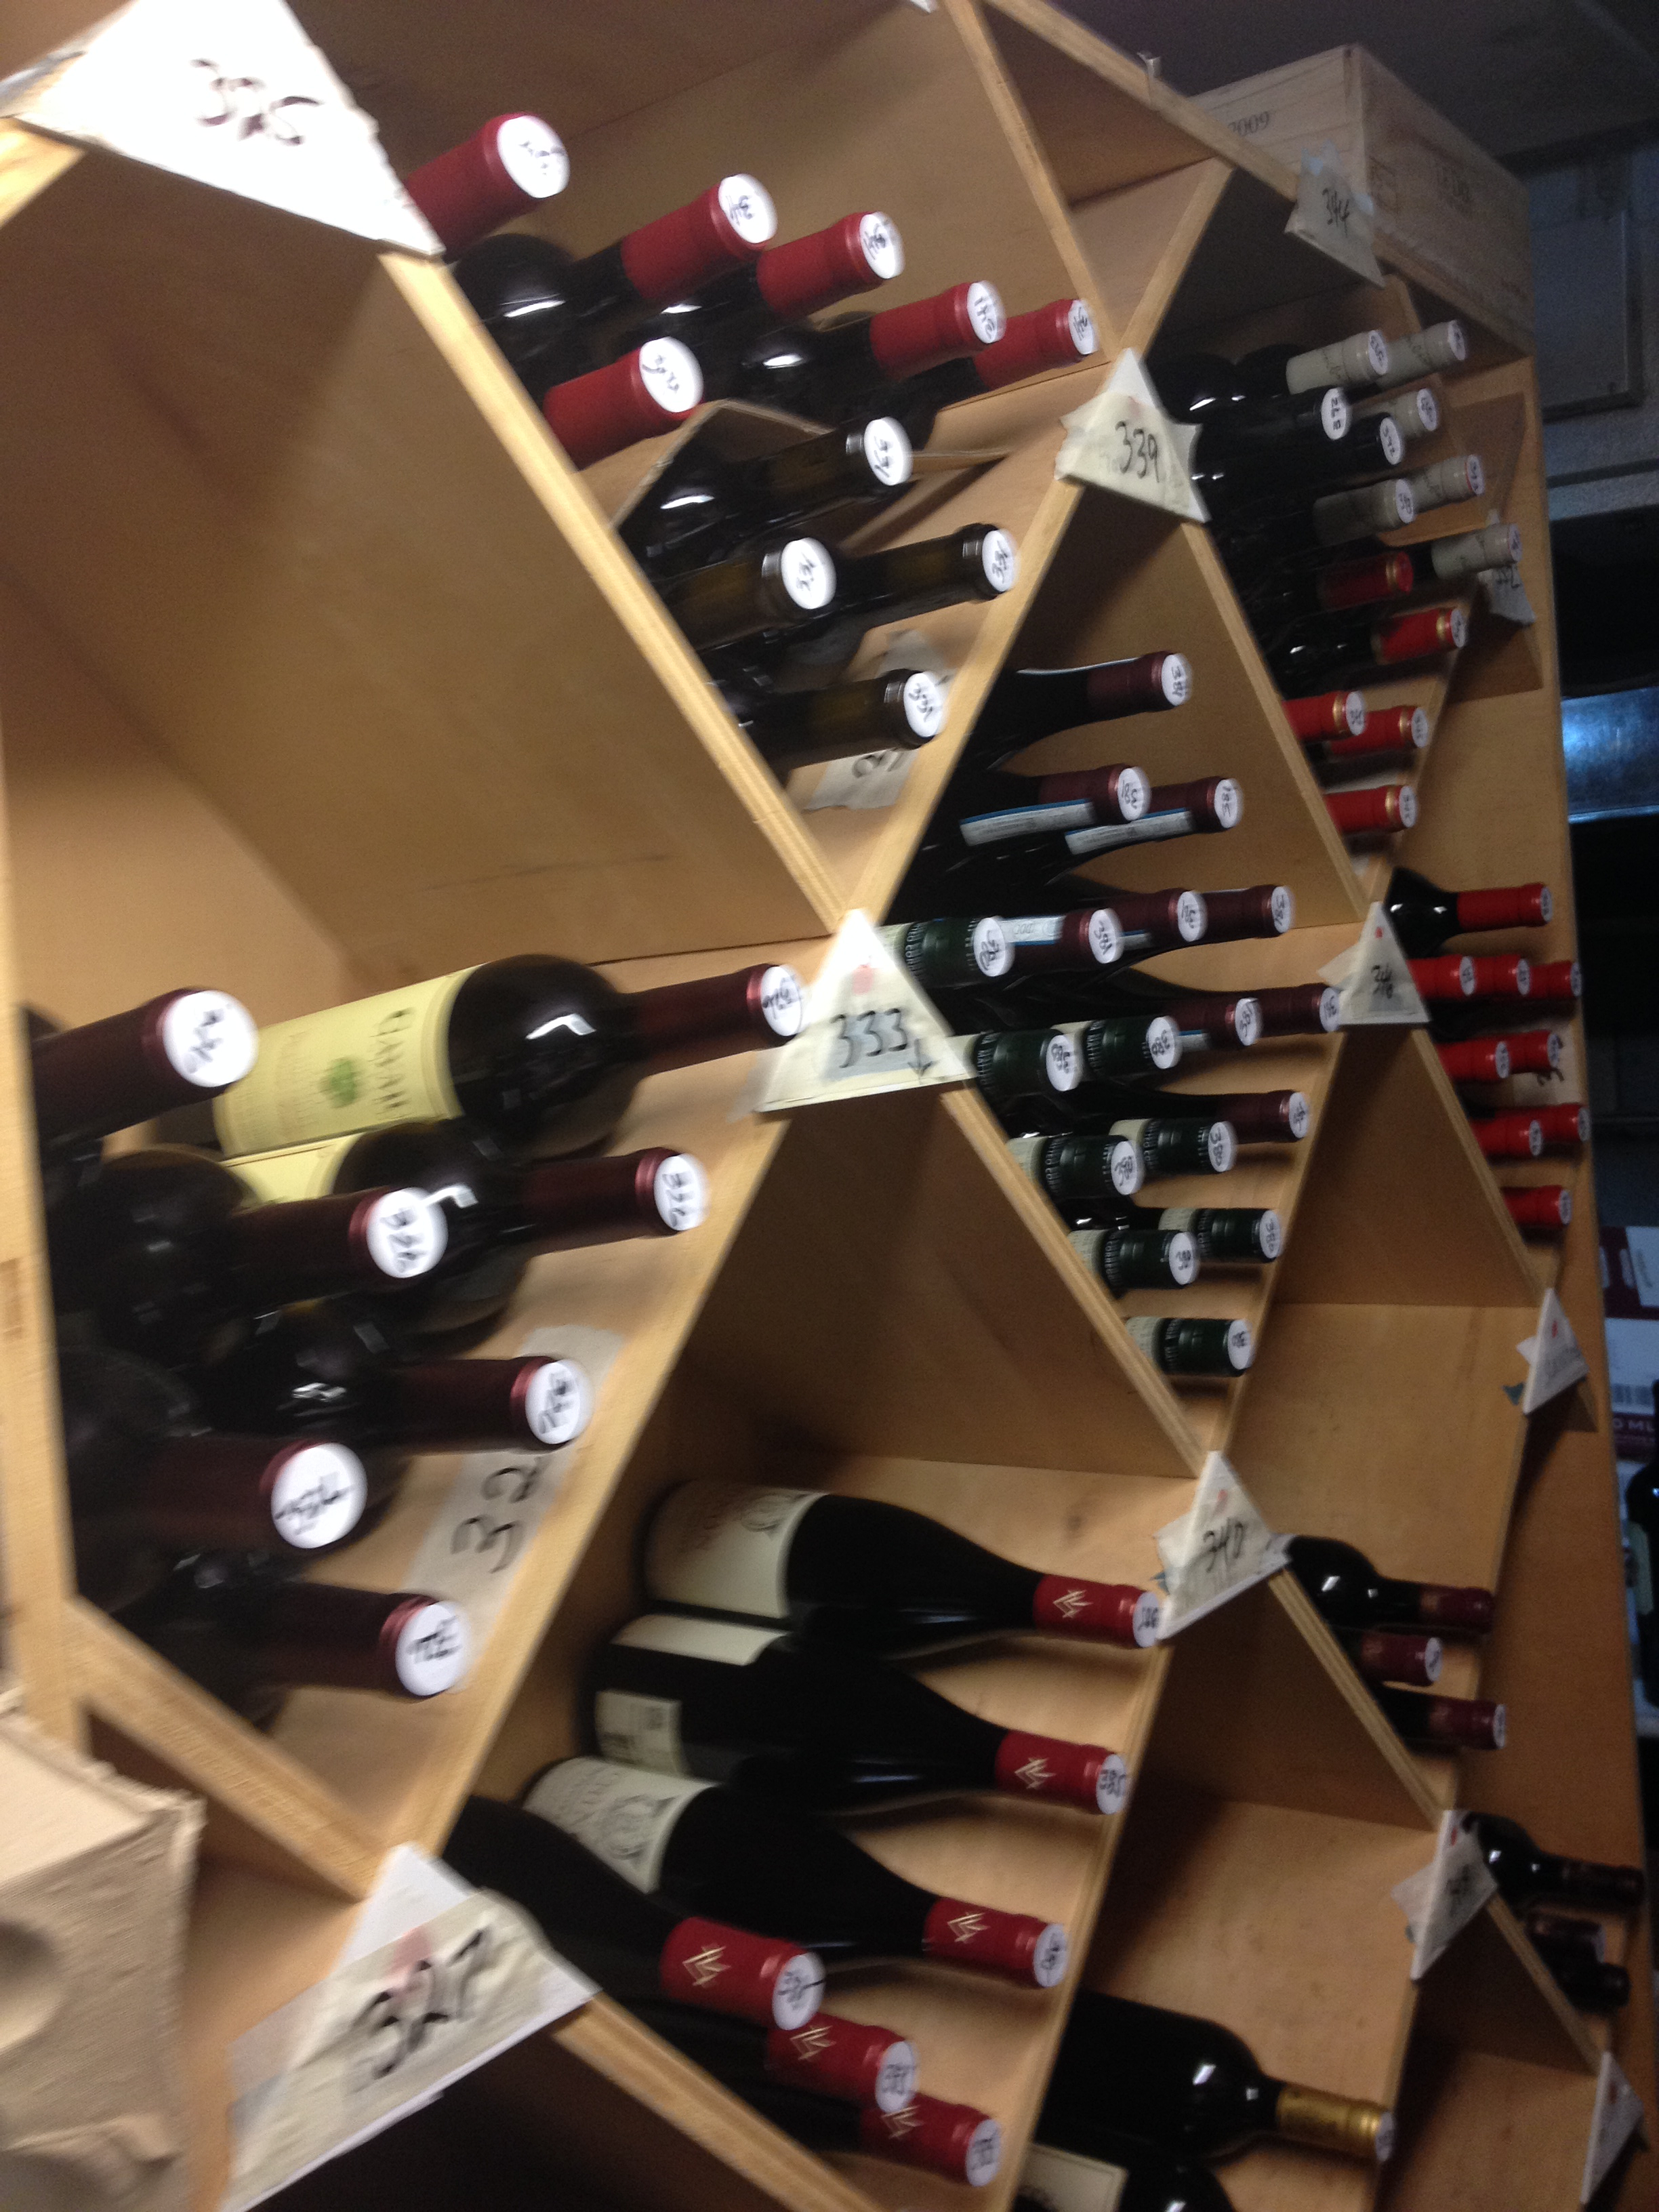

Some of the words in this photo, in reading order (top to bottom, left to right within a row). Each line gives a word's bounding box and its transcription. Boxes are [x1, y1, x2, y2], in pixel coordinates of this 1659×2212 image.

[1115, 419, 1161, 483] 339
[831, 1008, 909, 1069] 333
[1203, 1517, 1248, 1572] 340
